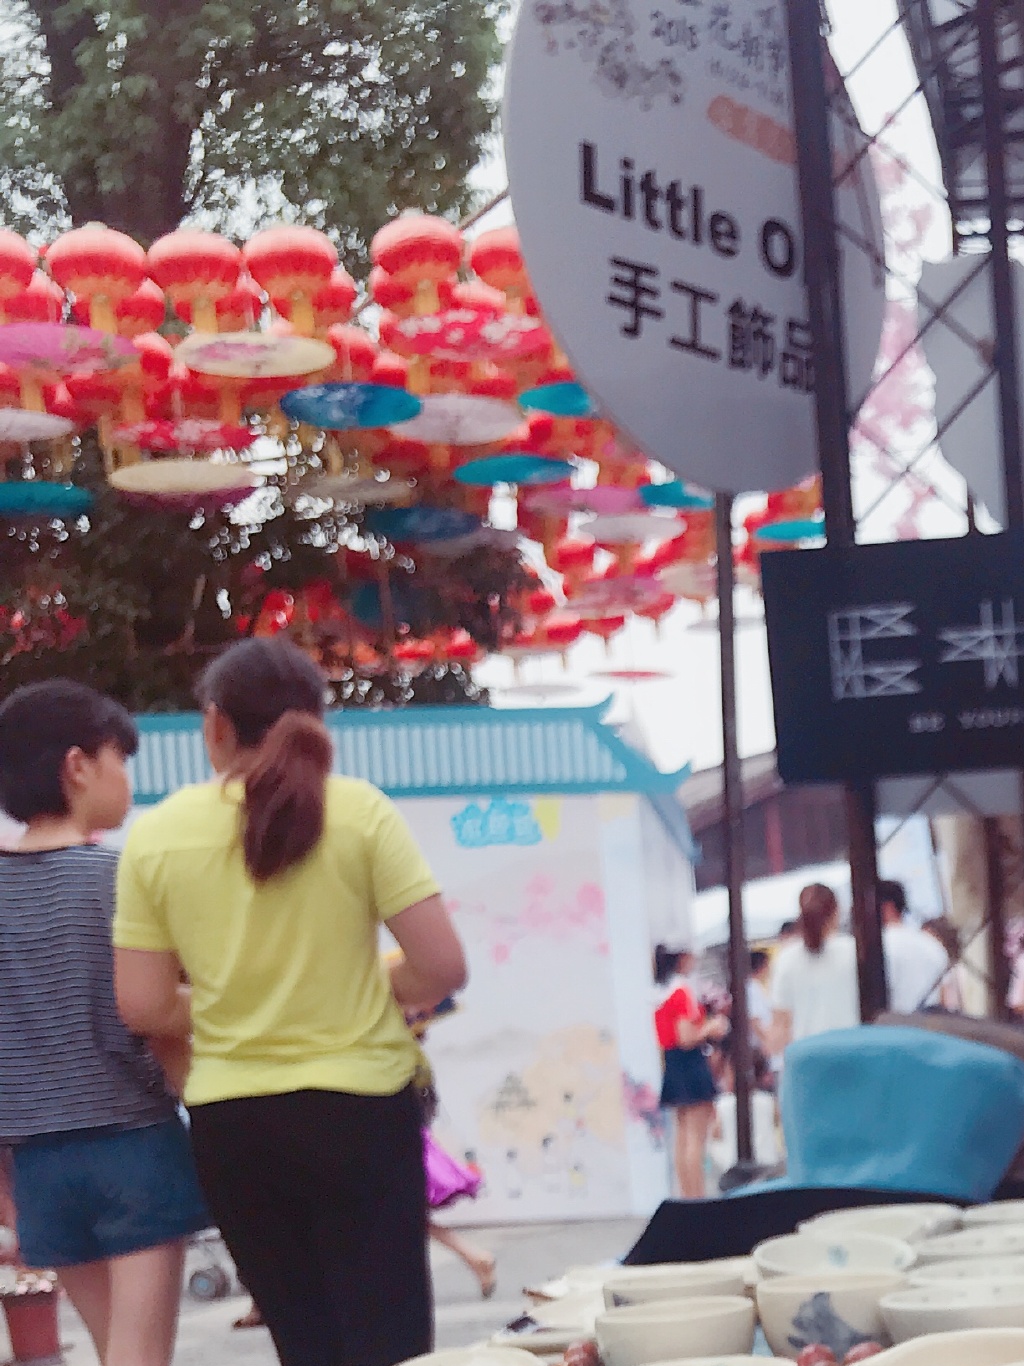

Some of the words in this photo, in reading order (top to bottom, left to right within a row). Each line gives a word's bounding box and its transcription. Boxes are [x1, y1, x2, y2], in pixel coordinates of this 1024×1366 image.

[578, 139, 739, 258] Little
[760, 218, 796, 278] O
[605, 256, 816, 394] 手工飾品
